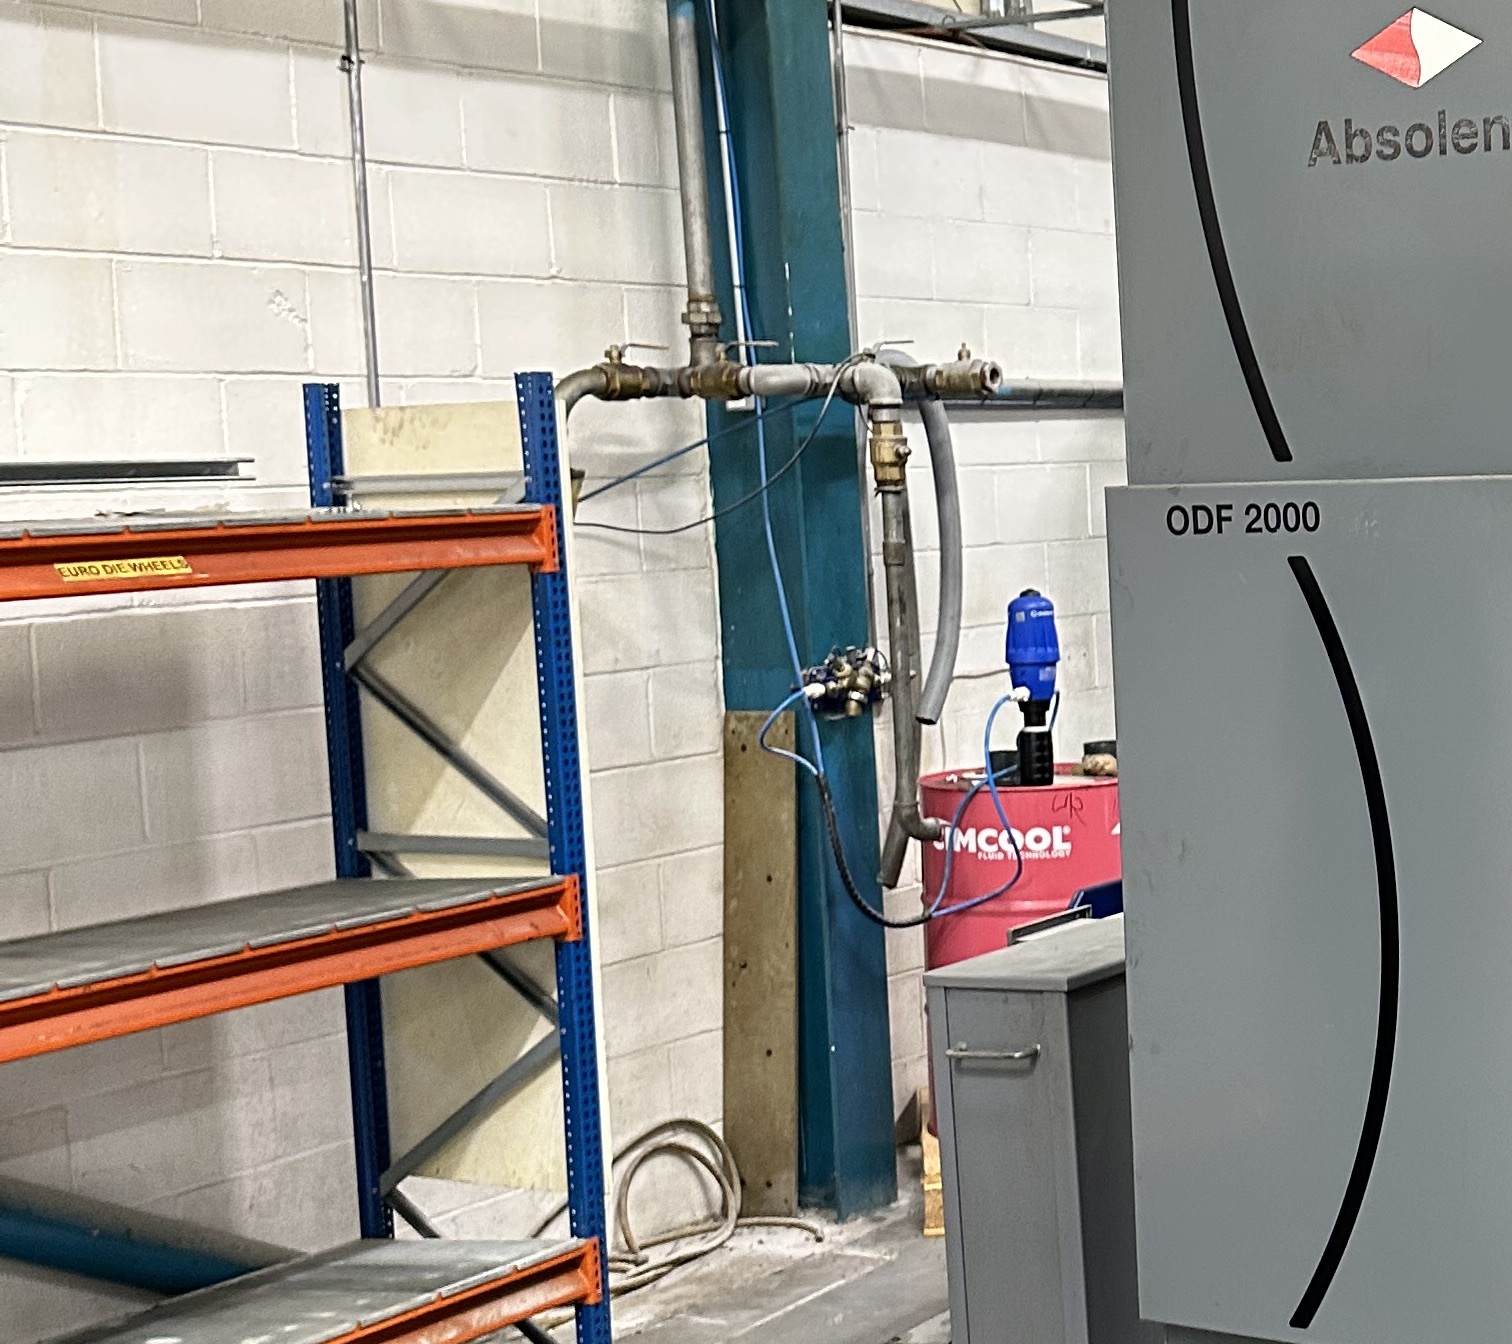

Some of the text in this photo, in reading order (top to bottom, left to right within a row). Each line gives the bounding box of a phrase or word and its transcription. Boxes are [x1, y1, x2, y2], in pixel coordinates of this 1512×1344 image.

[1166, 500, 1321, 536] ODF 2000
[57, 565, 100, 578] EURO
[101, 562, 129, 575] DIE
